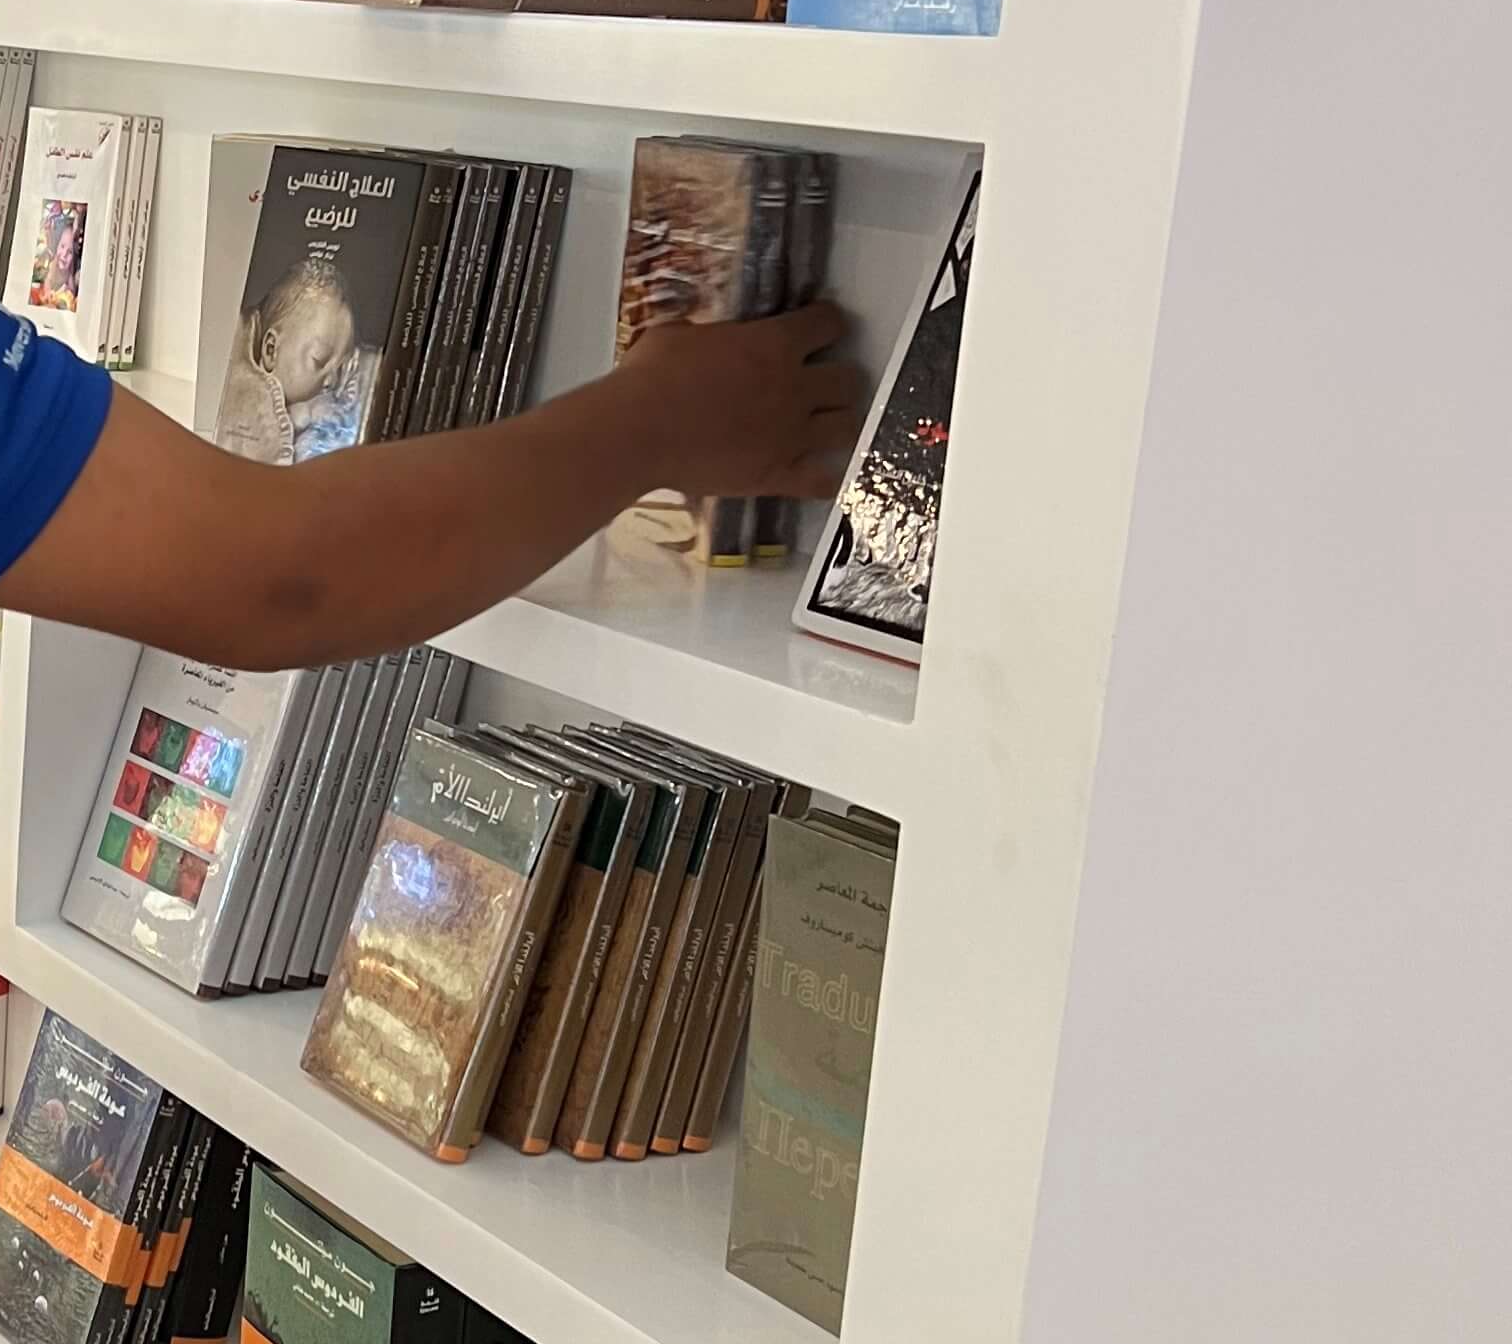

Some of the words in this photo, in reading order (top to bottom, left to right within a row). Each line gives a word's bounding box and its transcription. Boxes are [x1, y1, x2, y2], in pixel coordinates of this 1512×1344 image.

[287, 168, 349, 196] النفسي
[350, 175, 395, 199] العلاج
[304, 206, 357, 229] للرضيع
[311, 1276, 365, 1318] الفردوس
